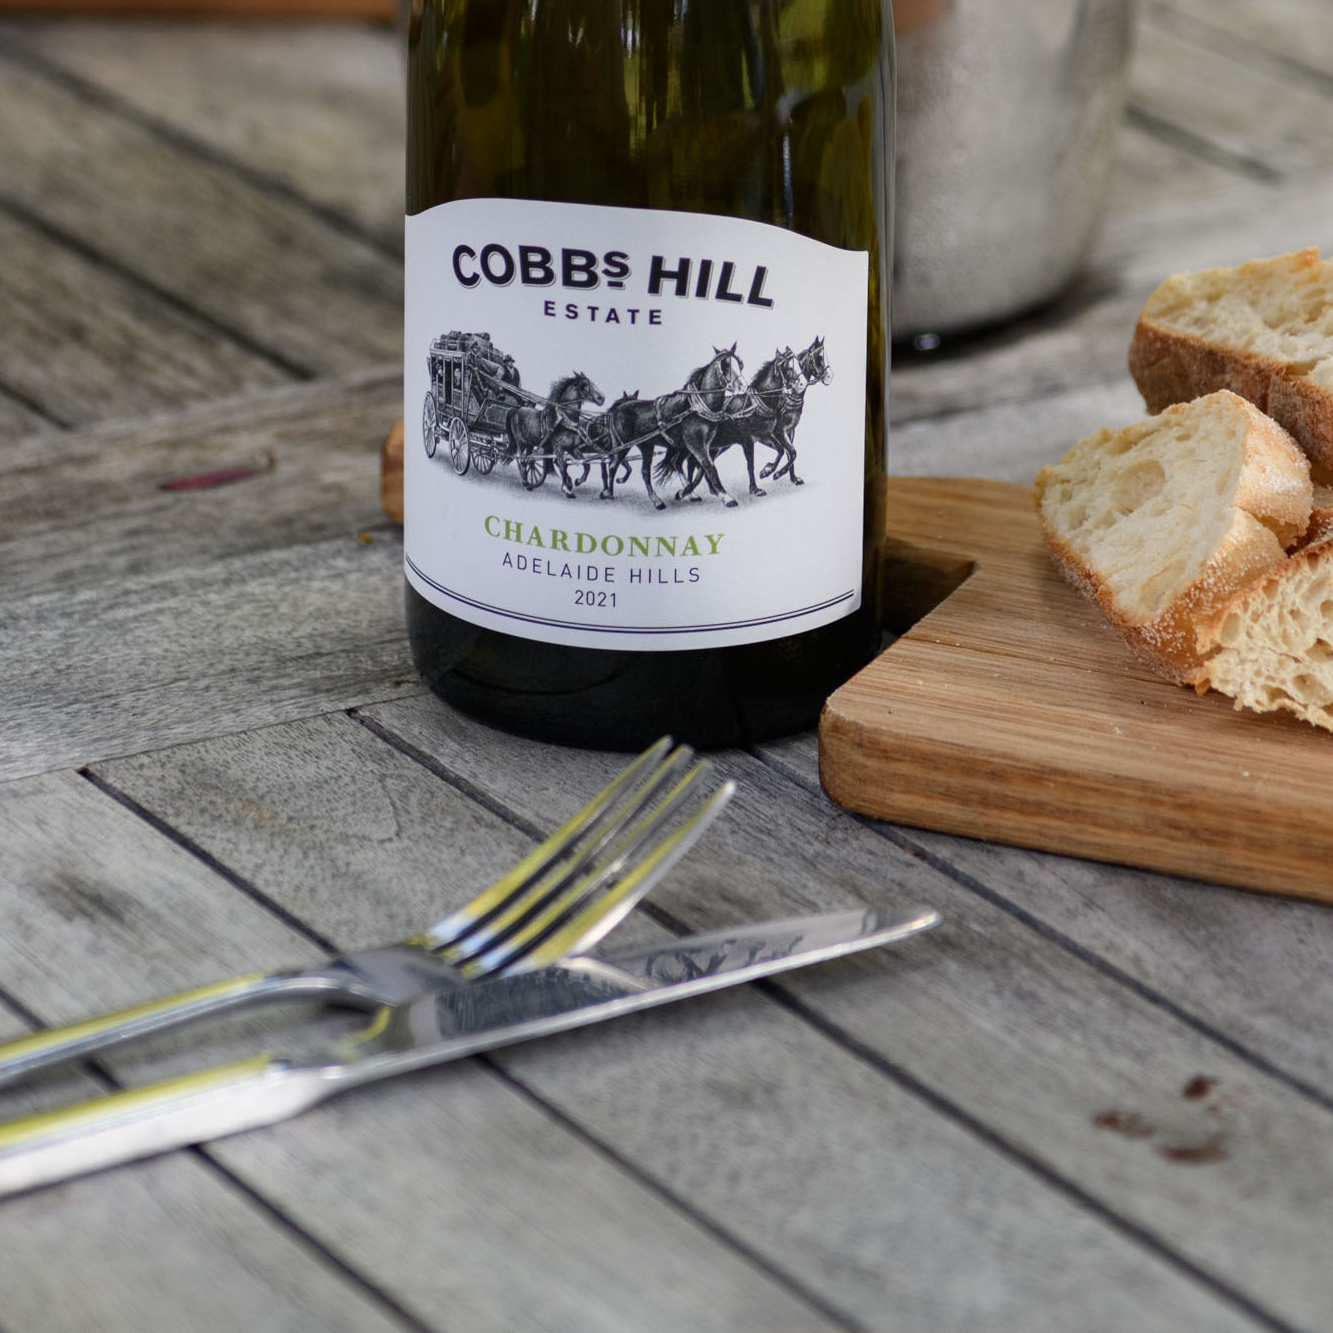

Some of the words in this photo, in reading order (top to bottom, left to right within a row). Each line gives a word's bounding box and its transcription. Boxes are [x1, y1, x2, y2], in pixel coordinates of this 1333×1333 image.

[452, 243, 632, 290] COBBS
[647, 255, 775, 310] HILL
[543, 299, 662, 325] ESTATE
[483, 515, 725, 557] CHARDONNAY
[501, 551, 616, 583] ADELAIDE
[629, 567, 700, 584] HILLS
[574, 589, 617, 608] 2021
